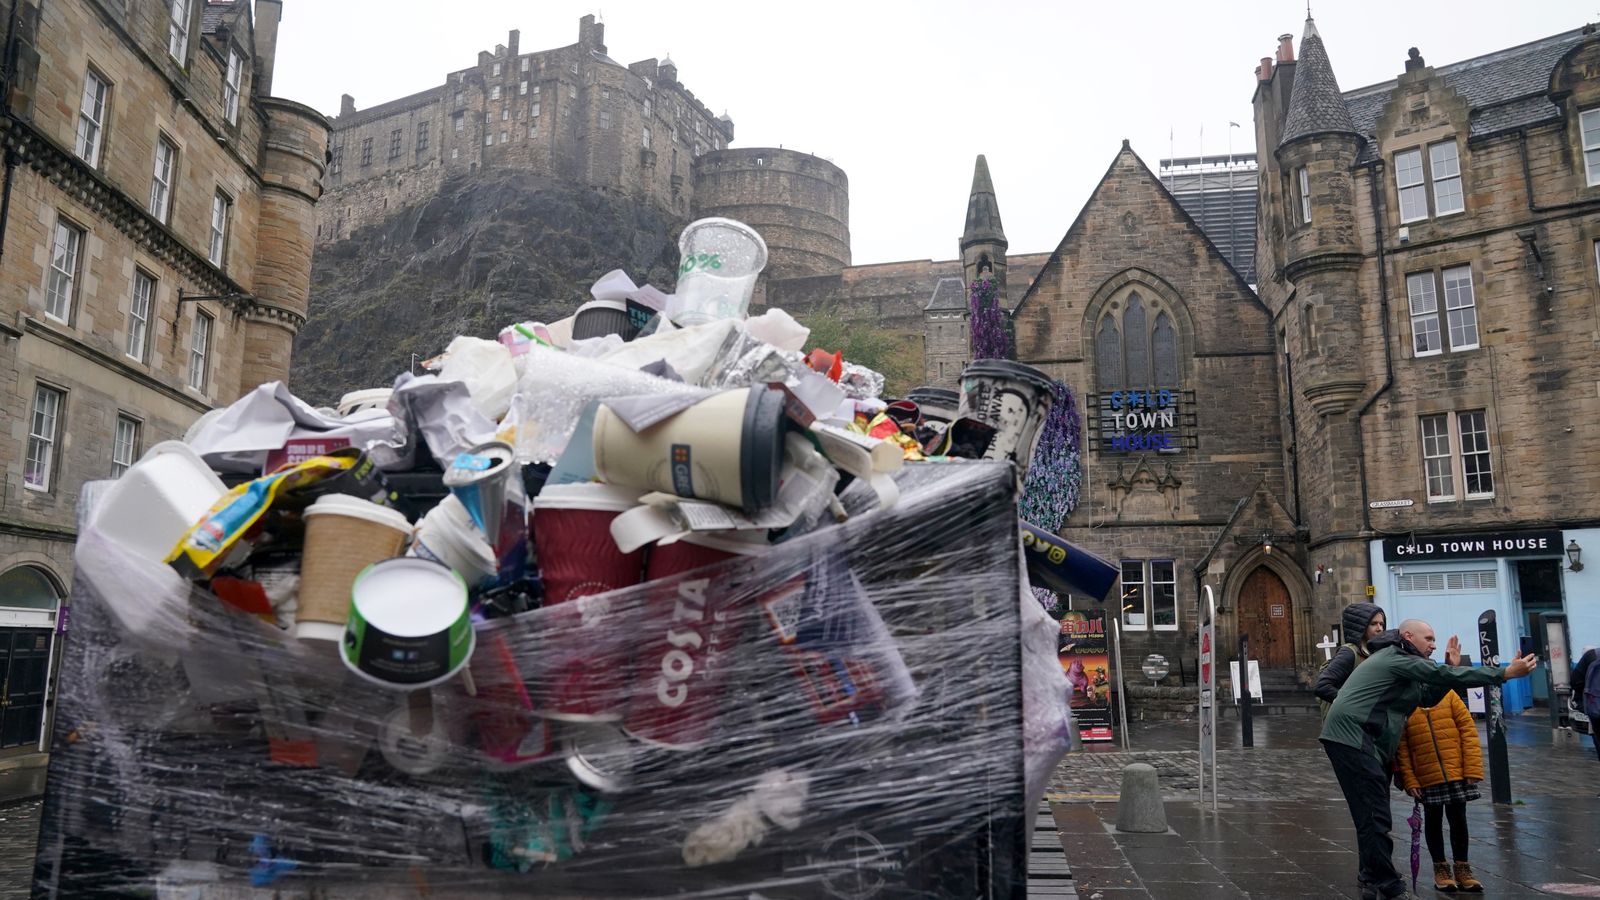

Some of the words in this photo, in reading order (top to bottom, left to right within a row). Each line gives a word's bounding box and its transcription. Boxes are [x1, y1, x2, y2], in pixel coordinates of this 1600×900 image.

[977, 385, 991, 421] OFFEE
[990, 386, 1003, 421] AWAY
[1112, 412, 1174, 429] TOWN
[1111, 433, 1174, 451] HOUSE
[1441, 541, 1485, 553] TOWN
[1493, 538, 1548, 550] HOUSE
[657, 578, 710, 708] COSTA
[702, 609, 727, 681] COFFEE
